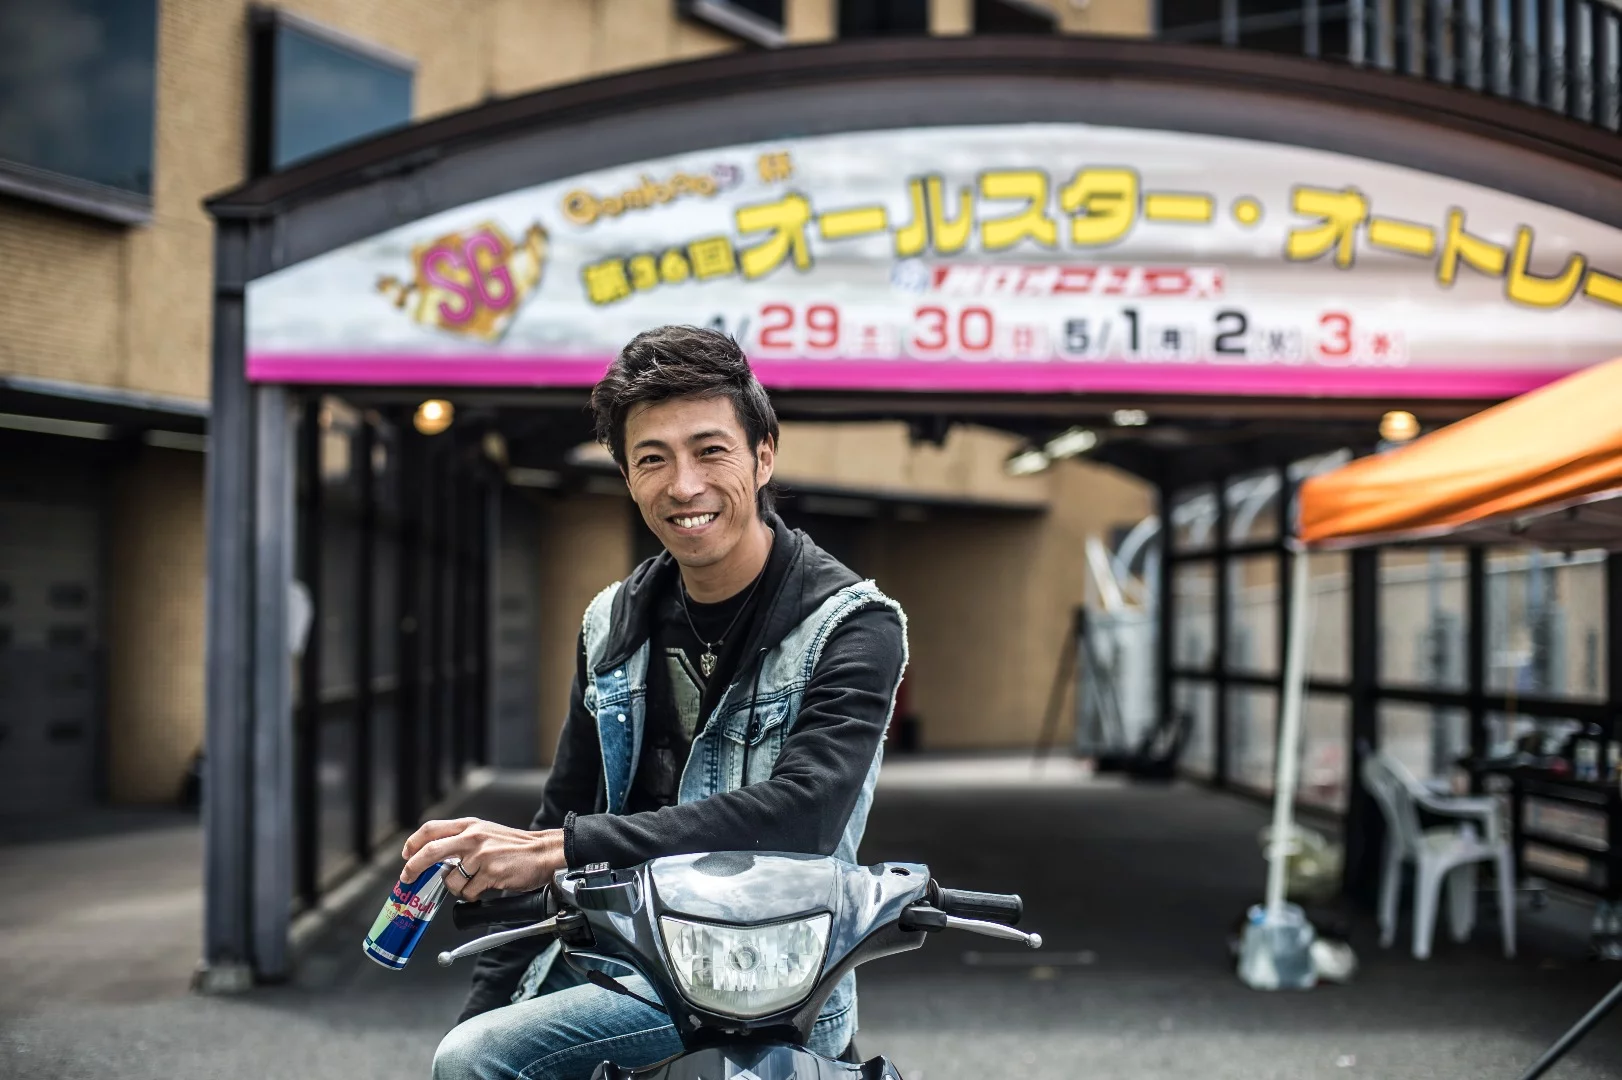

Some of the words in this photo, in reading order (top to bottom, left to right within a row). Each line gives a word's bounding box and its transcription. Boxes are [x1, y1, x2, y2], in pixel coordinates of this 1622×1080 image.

[421, 231, 515, 325] SG
[914, 305, 995, 351] 30
[1213, 311, 1248, 354] 2
[1318, 313, 1352, 356] 3
[409, 894, 436, 914] Bull
